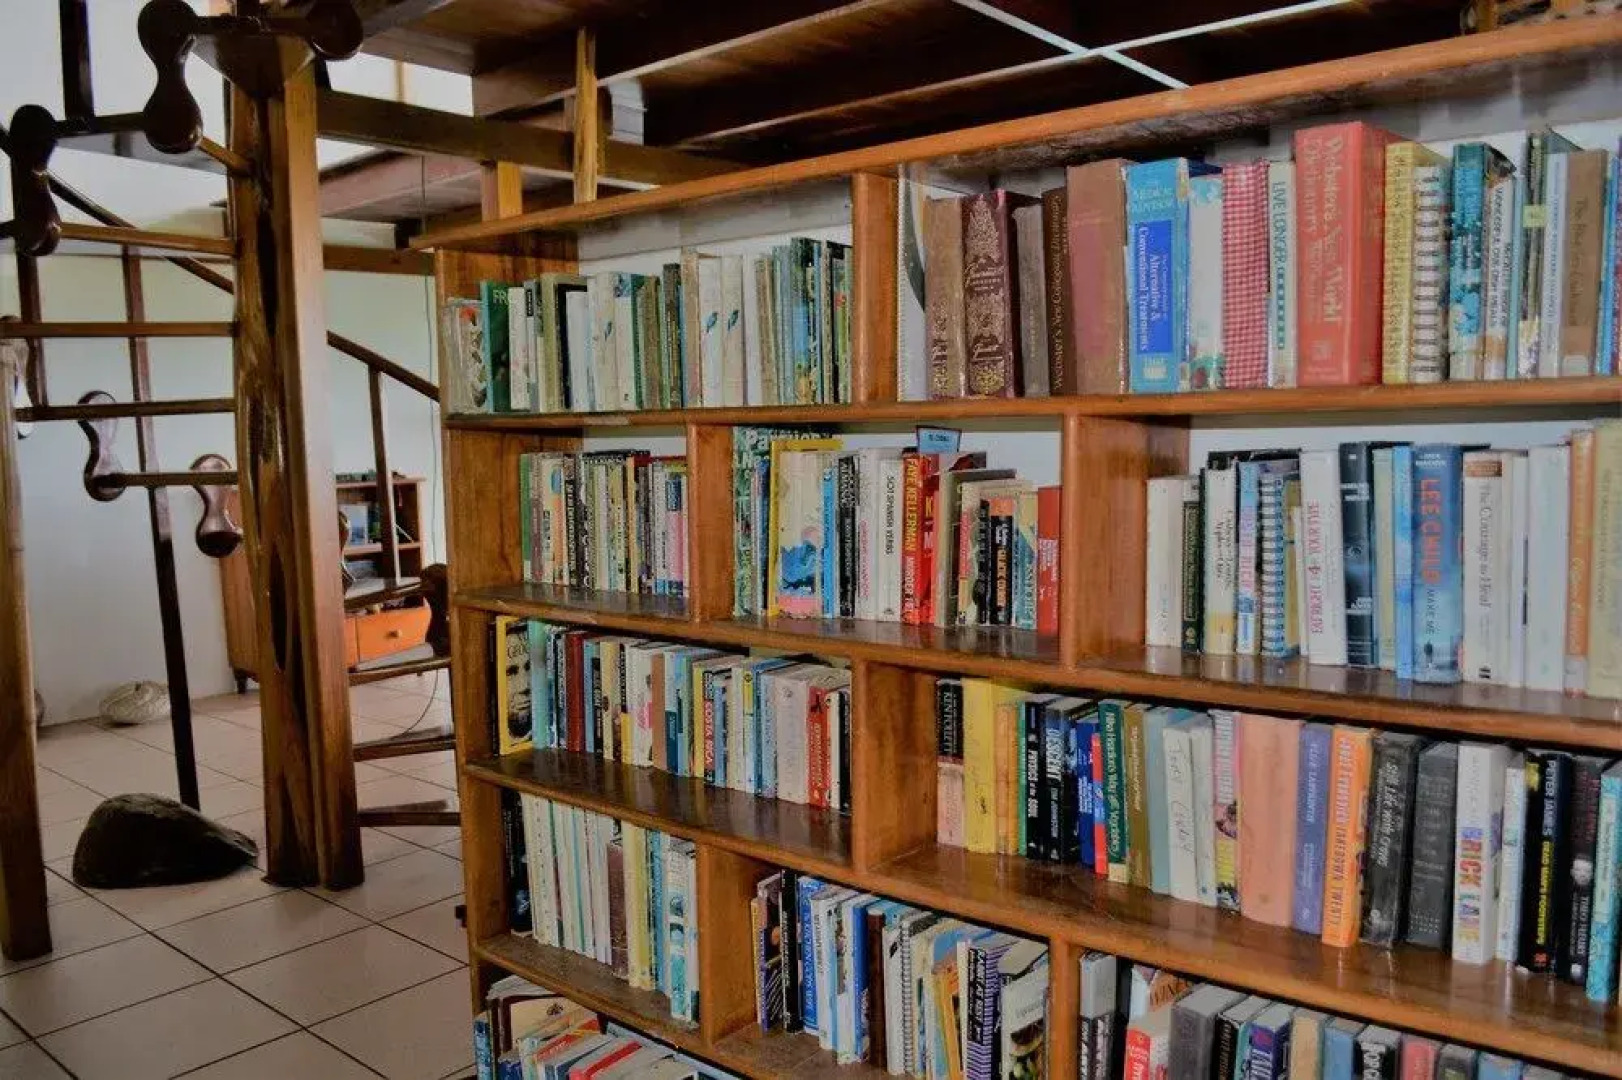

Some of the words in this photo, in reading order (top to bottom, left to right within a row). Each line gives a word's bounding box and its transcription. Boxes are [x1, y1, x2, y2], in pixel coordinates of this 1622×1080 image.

[1272, 181, 1286, 210] LIVE
[1273, 212, 1288, 264] LONGER
[1139, 226, 1151, 291] Conventional
[1150, 253, 1163, 310] Alternative
[1323, 266, 1344, 323] World
[1139, 293, 1150, 351] Treatments
[1051, 328, 1064, 390] Webster's
[904, 458, 917, 486] FAYE
[885, 495, 896, 528] SPANISH
[1420, 478, 1441, 514] LEE
[903, 487, 917, 551] KELLERMAN
[1478, 506, 1493, 561] Courage
[1420, 519, 1442, 584] CHILD
[904, 555, 916, 595] MURDER
[1478, 577, 1493, 609] Heal
[1424, 588, 1436, 616] MAKE
[1424, 620, 1436, 635] ME
[704, 701, 714, 738] COSTA
[943, 691, 954, 712] KEN
[943, 713, 954, 753] FOLLETT
[704, 740, 715, 766] RICA
[1046, 727, 1062, 782] DESCENT
[1386, 761, 1399, 786] Still
[1545, 760, 1556, 797] PETER
[1384, 786, 1397, 807] Life
[1381, 807, 1395, 835] with
[1542, 798, 1554, 836] JAMES
[1333, 826, 1347, 881] TAKEDOWN
[1377, 835, 1392, 867] Crows
[1459, 826, 1485, 888] BRICK
[1540, 841, 1552, 865] DEAD
[1538, 866, 1550, 894] MAN'S
[1329, 886, 1345, 925] TWENTY
[1458, 893, 1483, 942] LANE
[1536, 894, 1549, 945] FOOTSTEPS
[1577, 923, 1588, 956] FLEURY
